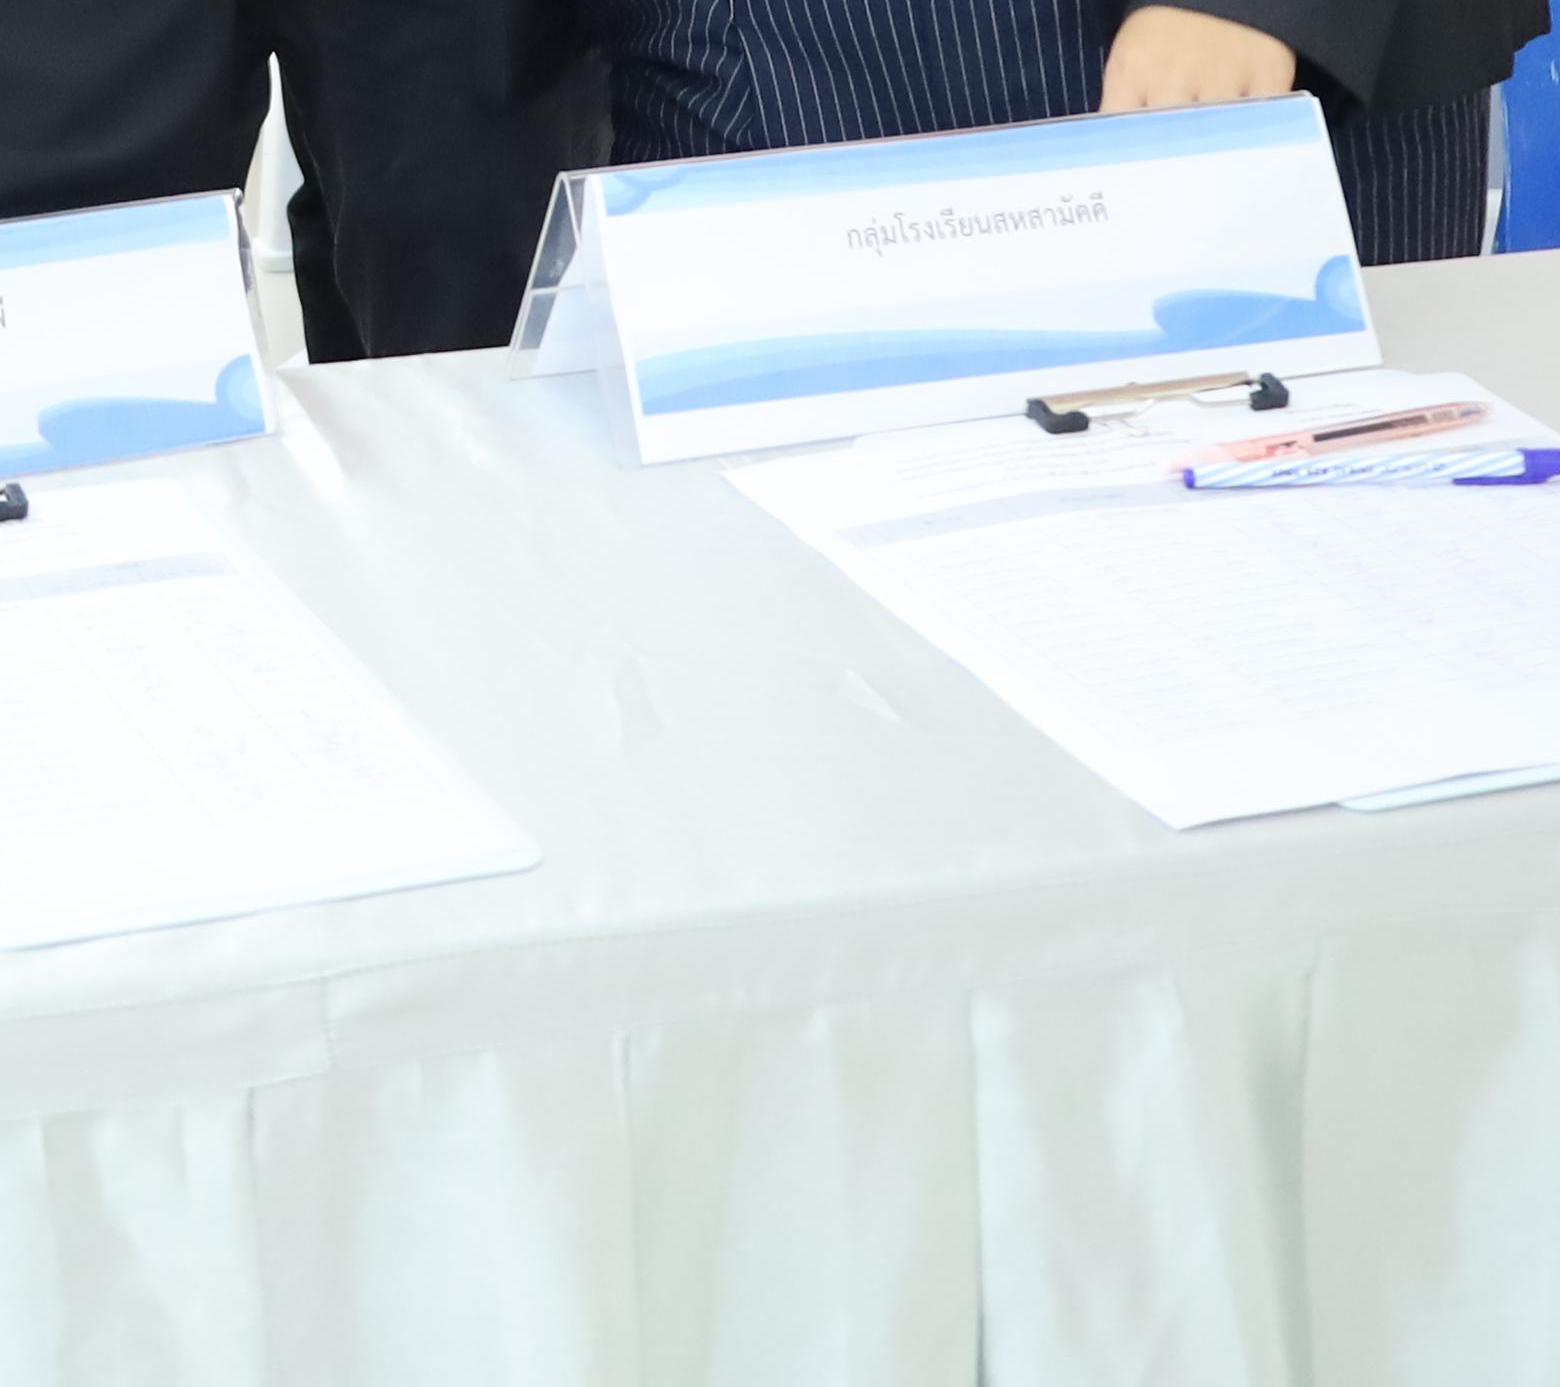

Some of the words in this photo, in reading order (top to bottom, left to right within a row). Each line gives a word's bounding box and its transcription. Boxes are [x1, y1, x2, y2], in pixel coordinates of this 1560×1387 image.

[846, 191, 1110, 258] กลุ่มโรงเรียนสหสามัคคี
